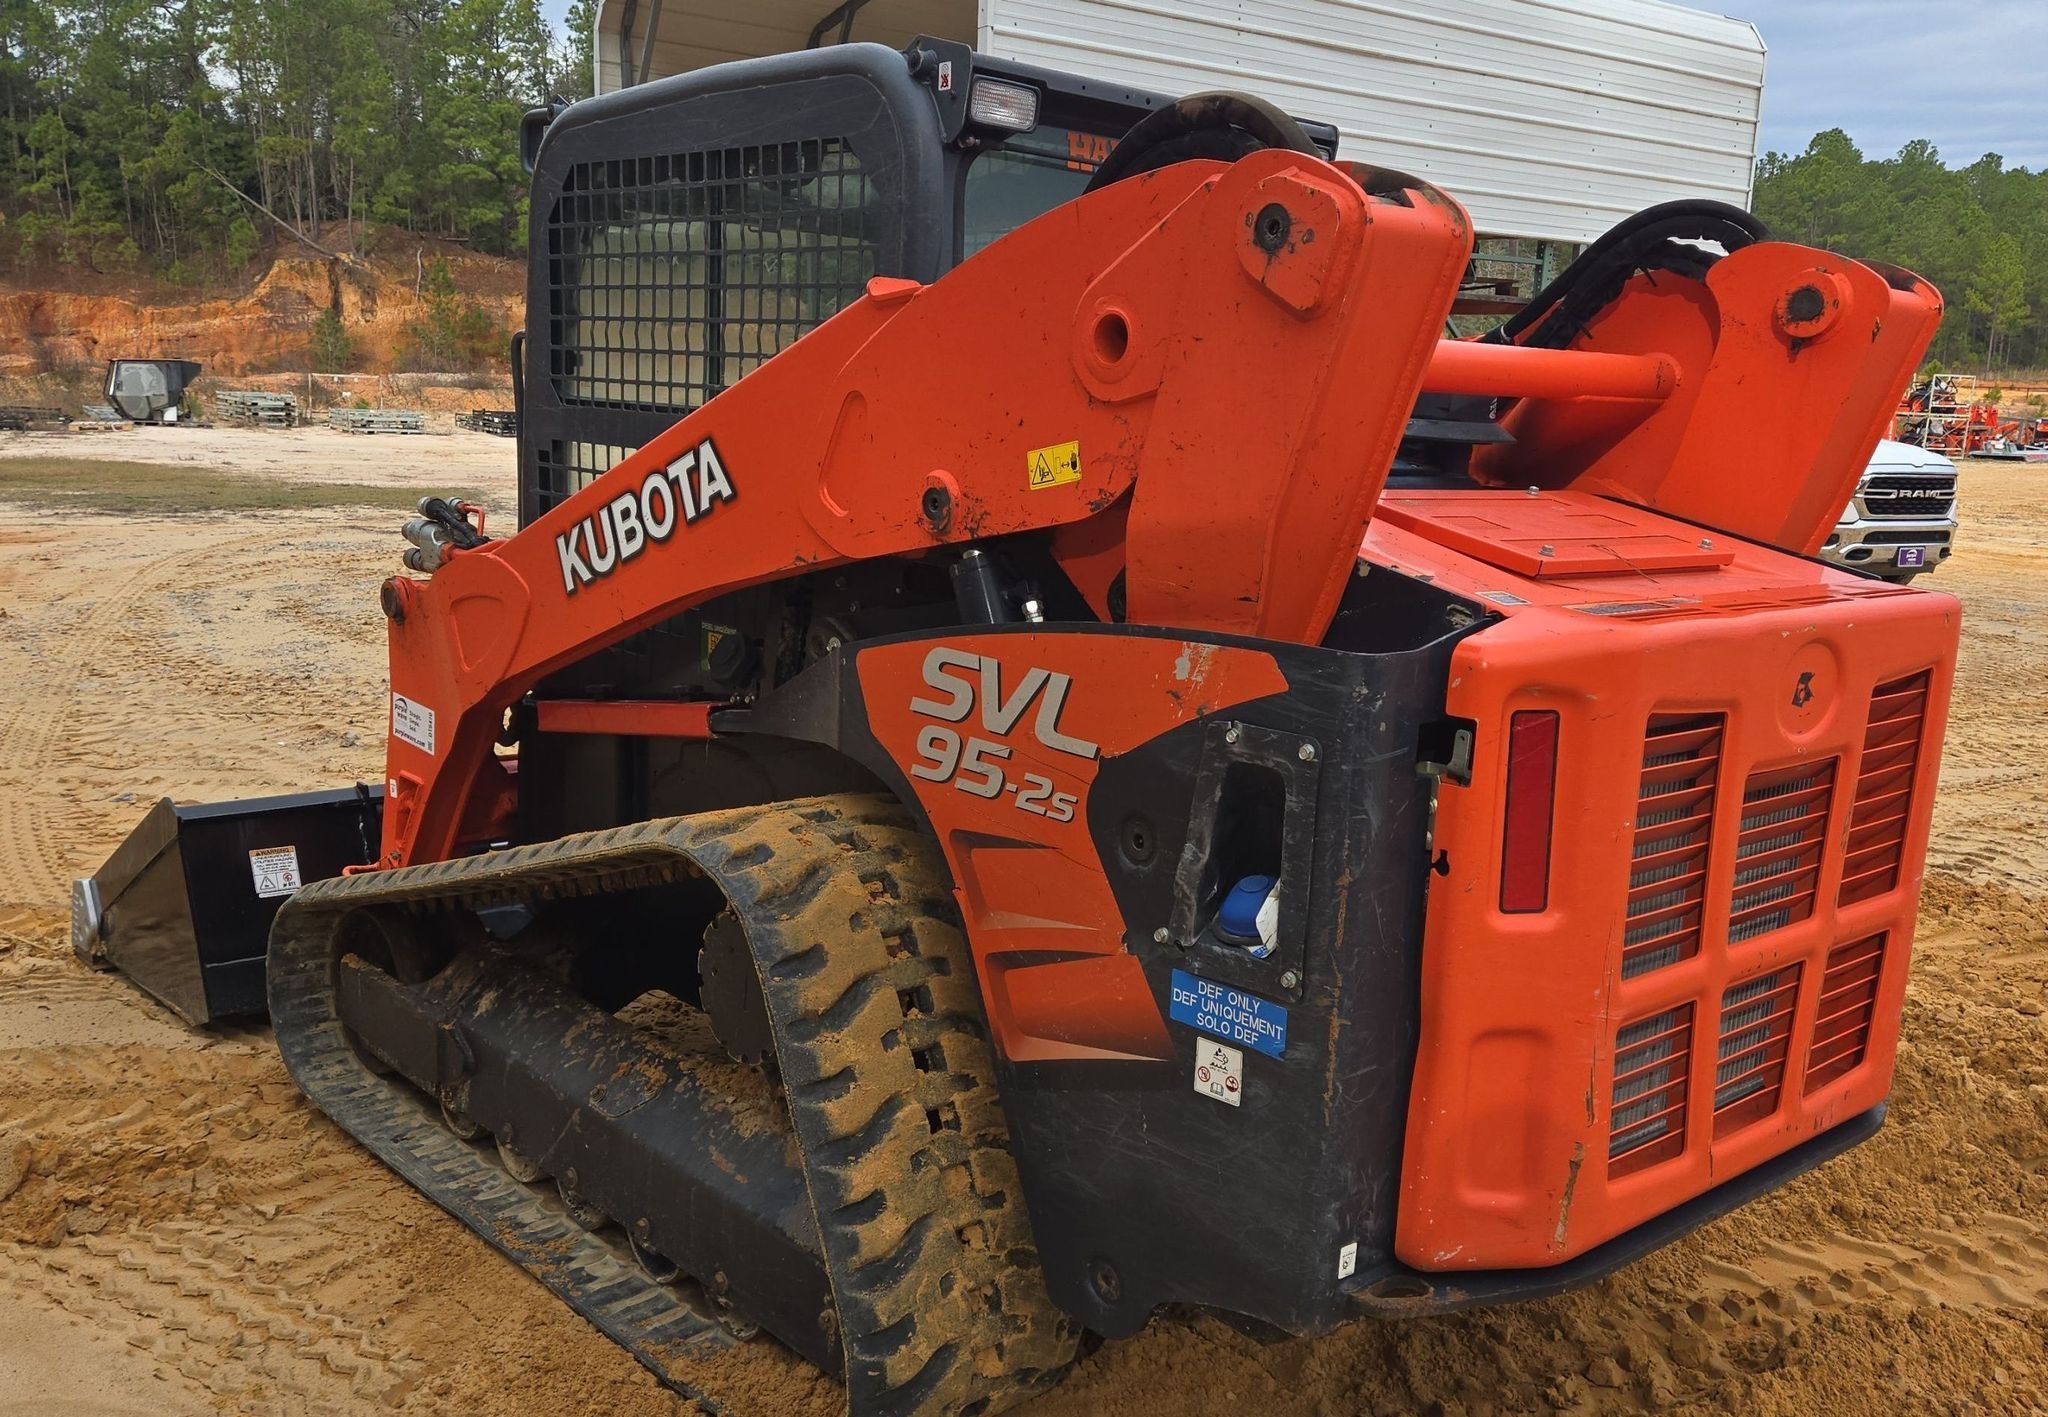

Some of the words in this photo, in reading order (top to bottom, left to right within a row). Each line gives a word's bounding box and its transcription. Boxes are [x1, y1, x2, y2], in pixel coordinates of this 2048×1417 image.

[1899, 489, 1940, 498] RAM
[555, 440, 733, 593] KUBOTA
[909, 646, 1100, 761] SVL
[1173, 988, 1198, 1006] DEF
[1201, 998, 1284, 1040] UNIQUEMENT
[1198, 981, 1223, 999] DEF
[1228, 992, 1260, 1014] ONLY
[1196, 1012, 1230, 1035] SOLO
[1234, 1025, 1259, 1045] DEF
